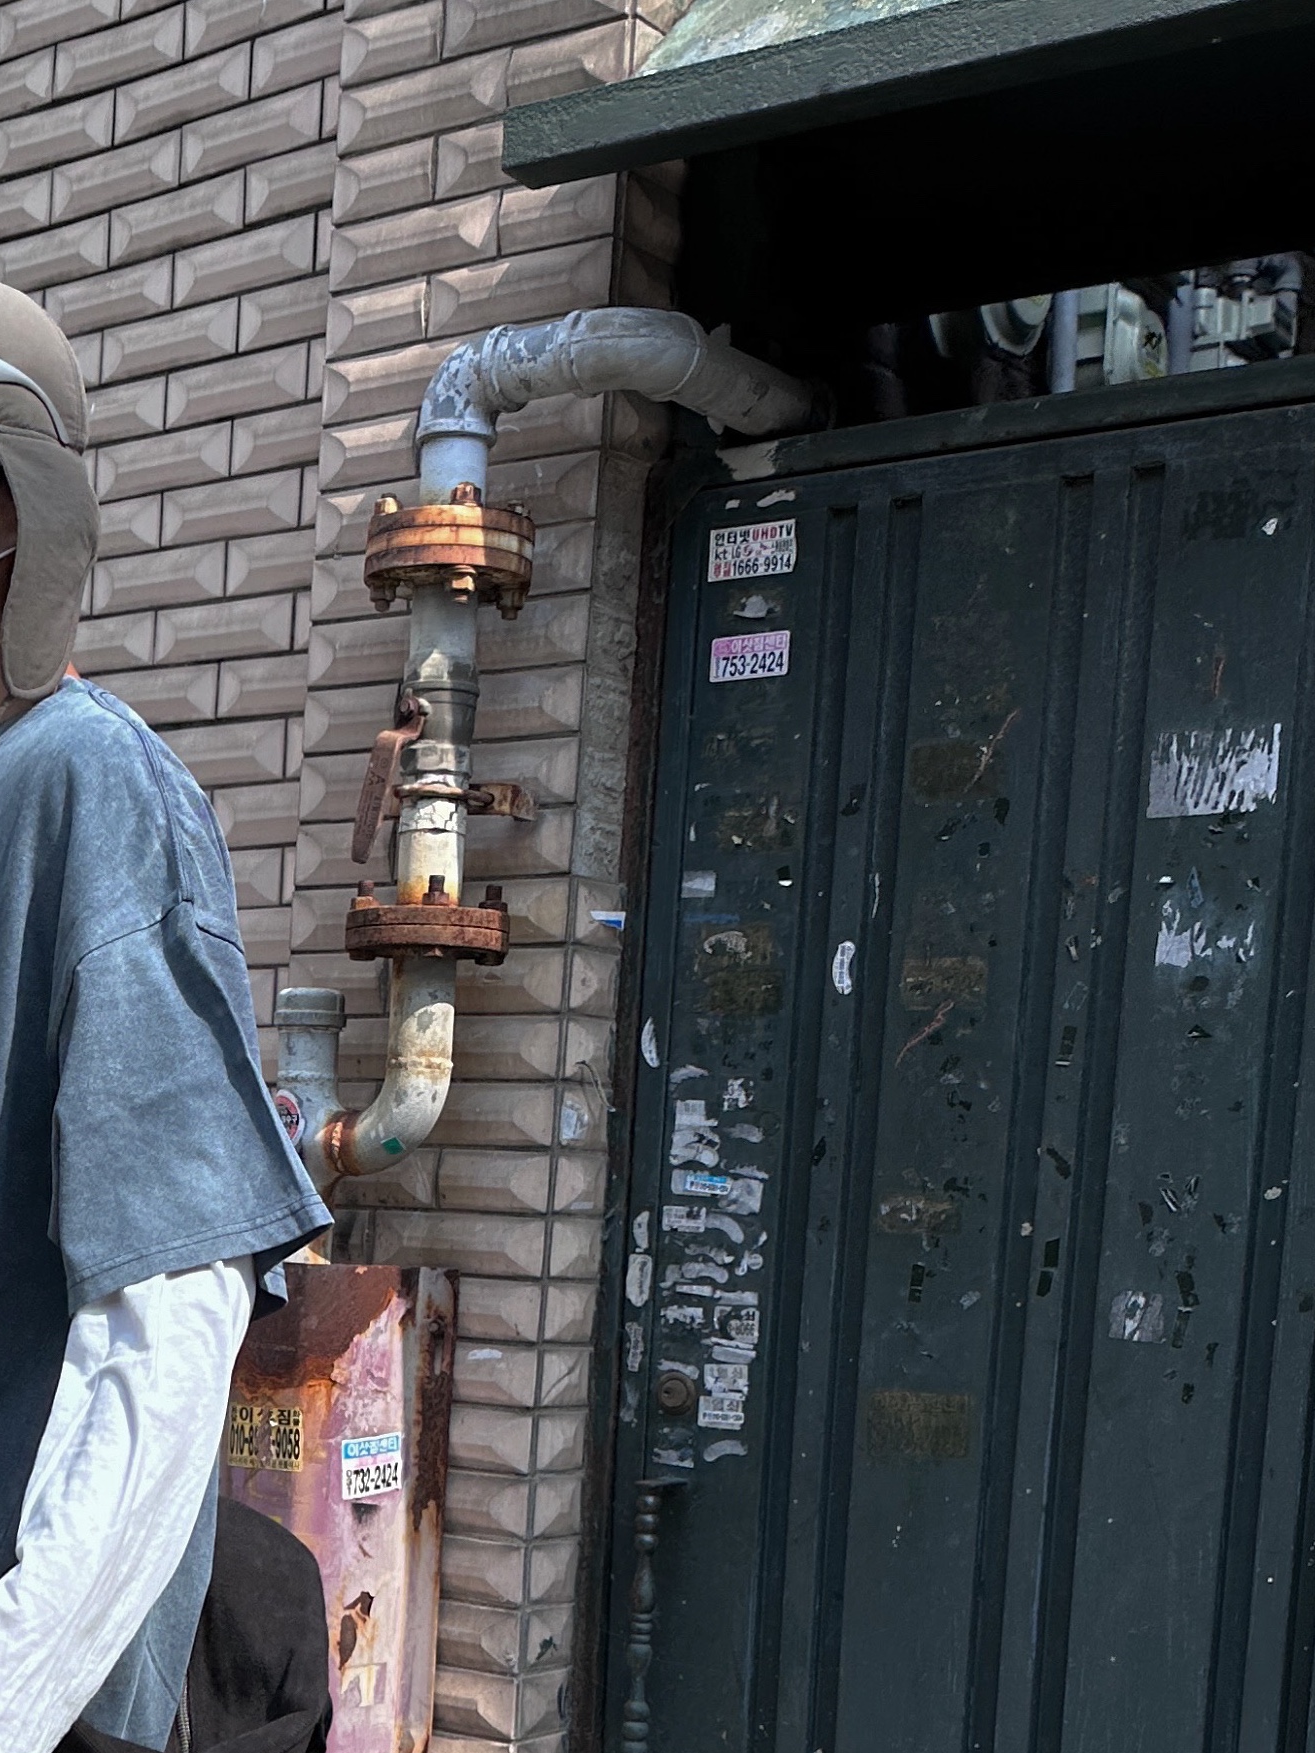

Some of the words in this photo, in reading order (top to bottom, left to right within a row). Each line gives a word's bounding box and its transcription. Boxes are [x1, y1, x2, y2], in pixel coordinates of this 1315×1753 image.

[733, 553, 792, 576] 1666-9914
[721, 651, 785, 677] 753-2424
[353, 1461, 399, 1495] 732-2424
